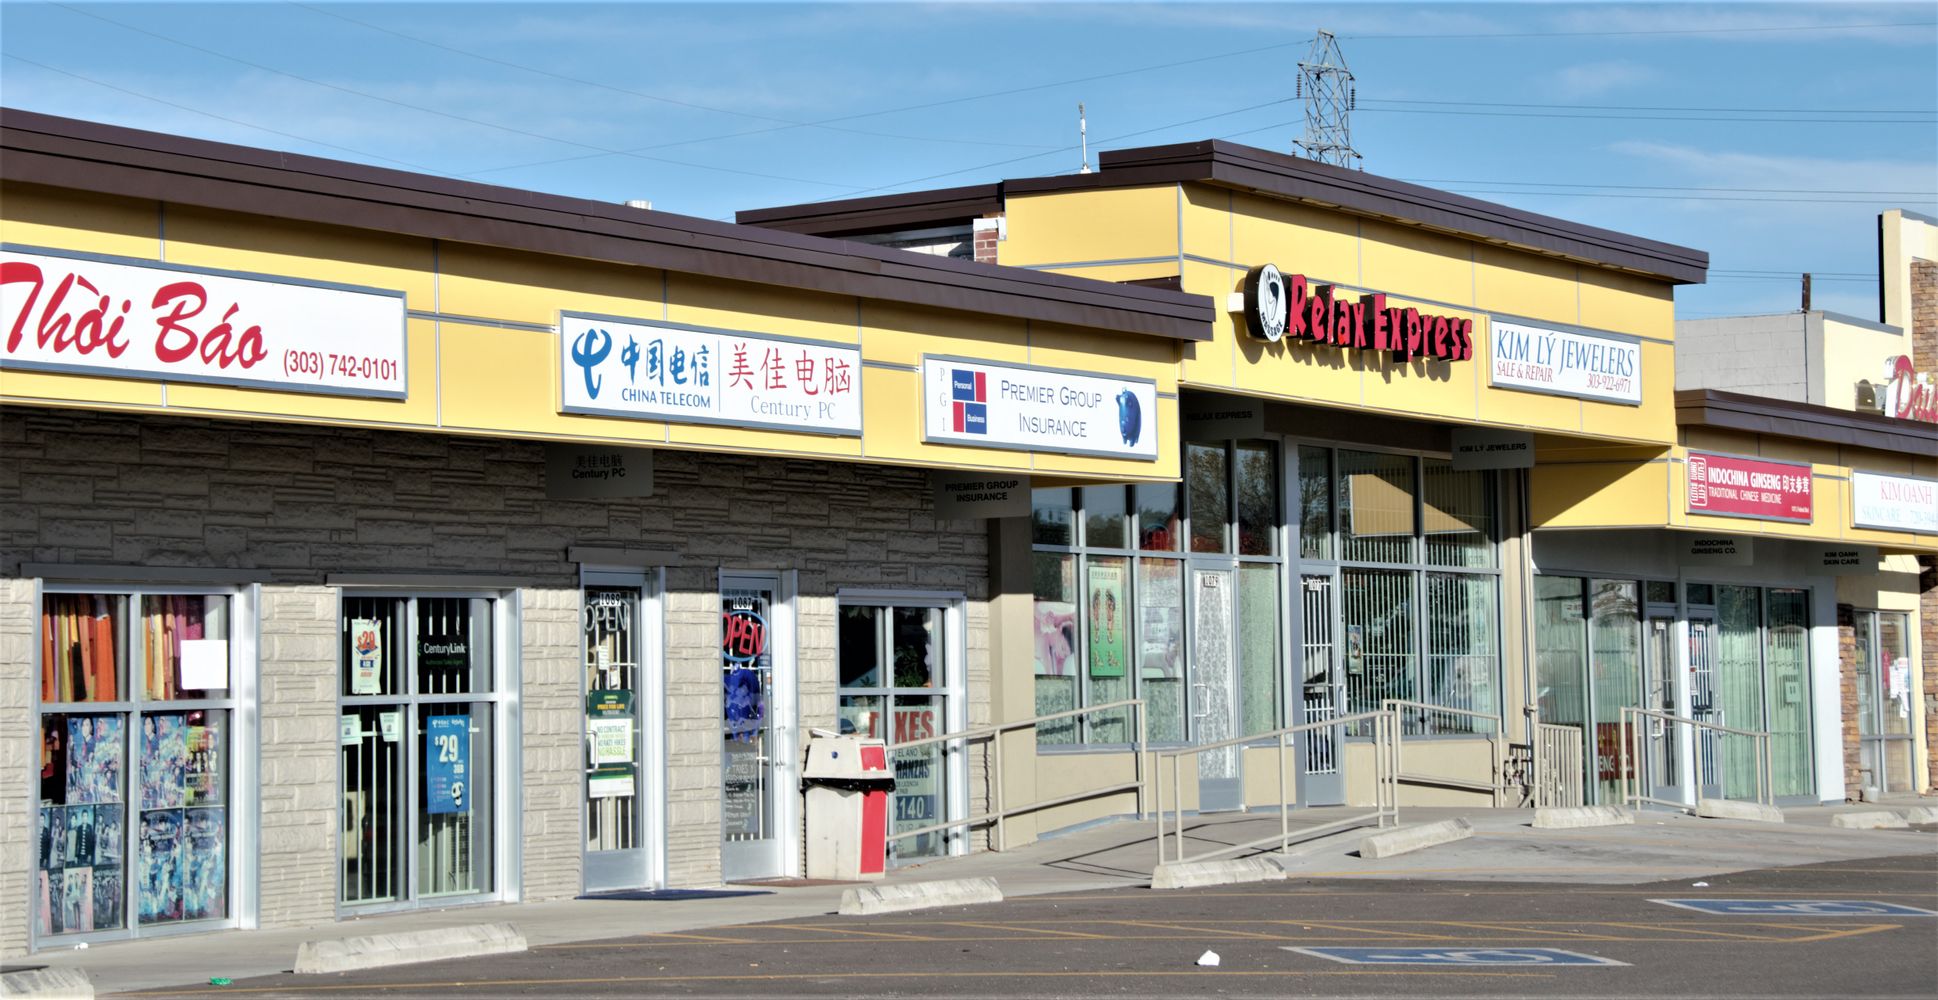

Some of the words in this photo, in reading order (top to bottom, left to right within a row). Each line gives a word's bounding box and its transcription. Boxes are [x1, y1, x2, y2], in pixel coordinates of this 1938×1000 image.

[151, 281, 268, 370] Báo
[1288, 273, 1367, 349] Relax
[1374, 293, 1473, 362] Express
[283, 348, 325, 380] (303)
[328, 353, 399, 381] 742-0101
[620, 333, 711, 388] 中国电信
[1496, 329, 1530, 363] KIM
[1537, 332, 1556, 366] LÝ
[1558, 338, 1635, 378] JEWELERS
[727, 342, 851, 396] 美佳电脑
[1496, 360, 1516, 377] SALE
[1517, 363, 1524, 379] &
[1525, 364, 1554, 383] REPAIR
[953, 380, 973, 391] Personal
[1000, 379, 1055, 405] PREMIER
[1059, 385, 1102, 409] GROUP
[1586, 372, 1632, 394] 303-922-6971
[621, 387, 658, 404] CHINA
[659, 391, 711, 409] TELECOM
[750, 395, 812, 421] Century
[818, 400, 837, 421] PC
[967, 413, 986, 424] Business
[1018, 412, 1088, 438] INSURANCE
[1214, 410, 1253, 420] EXPRESS
[1486, 443, 1527, 452] JEWELERS
[572, 468, 609, 480] Century
[612, 468, 626, 478] PC
[1707, 466, 1750, 487] INDOCHINA
[1750, 471, 1781, 491] GINSENG
[945, 481, 985, 493] PREMIER
[986, 480, 1019, 491] GROUP
[956, 491, 1008, 502] INSURANCE
[1708, 486, 1739, 501] TRADITIONAL
[1740, 490, 1760, 503] CHINESE
[1761, 492, 1783, 505] MEDICINE
[1880, 480, 1902, 502] KIM
[1903, 483, 1933, 505] OANH
[1694, 539, 1734, 547] INDOCHINA
[1823, 558, 1840, 566] SKIN
[600, 593, 620, 605] 1089
[734, 596, 752, 609] 1087
[584, 604, 628, 632] OPEN
[723, 612, 766, 657] OPEN
[423, 642, 467, 657] CenturyLink
[869, 710, 934, 744] TXES
[434, 735, 459, 763] $29
[896, 759, 930, 779] RANZAS
[896, 796, 925, 819] 140
